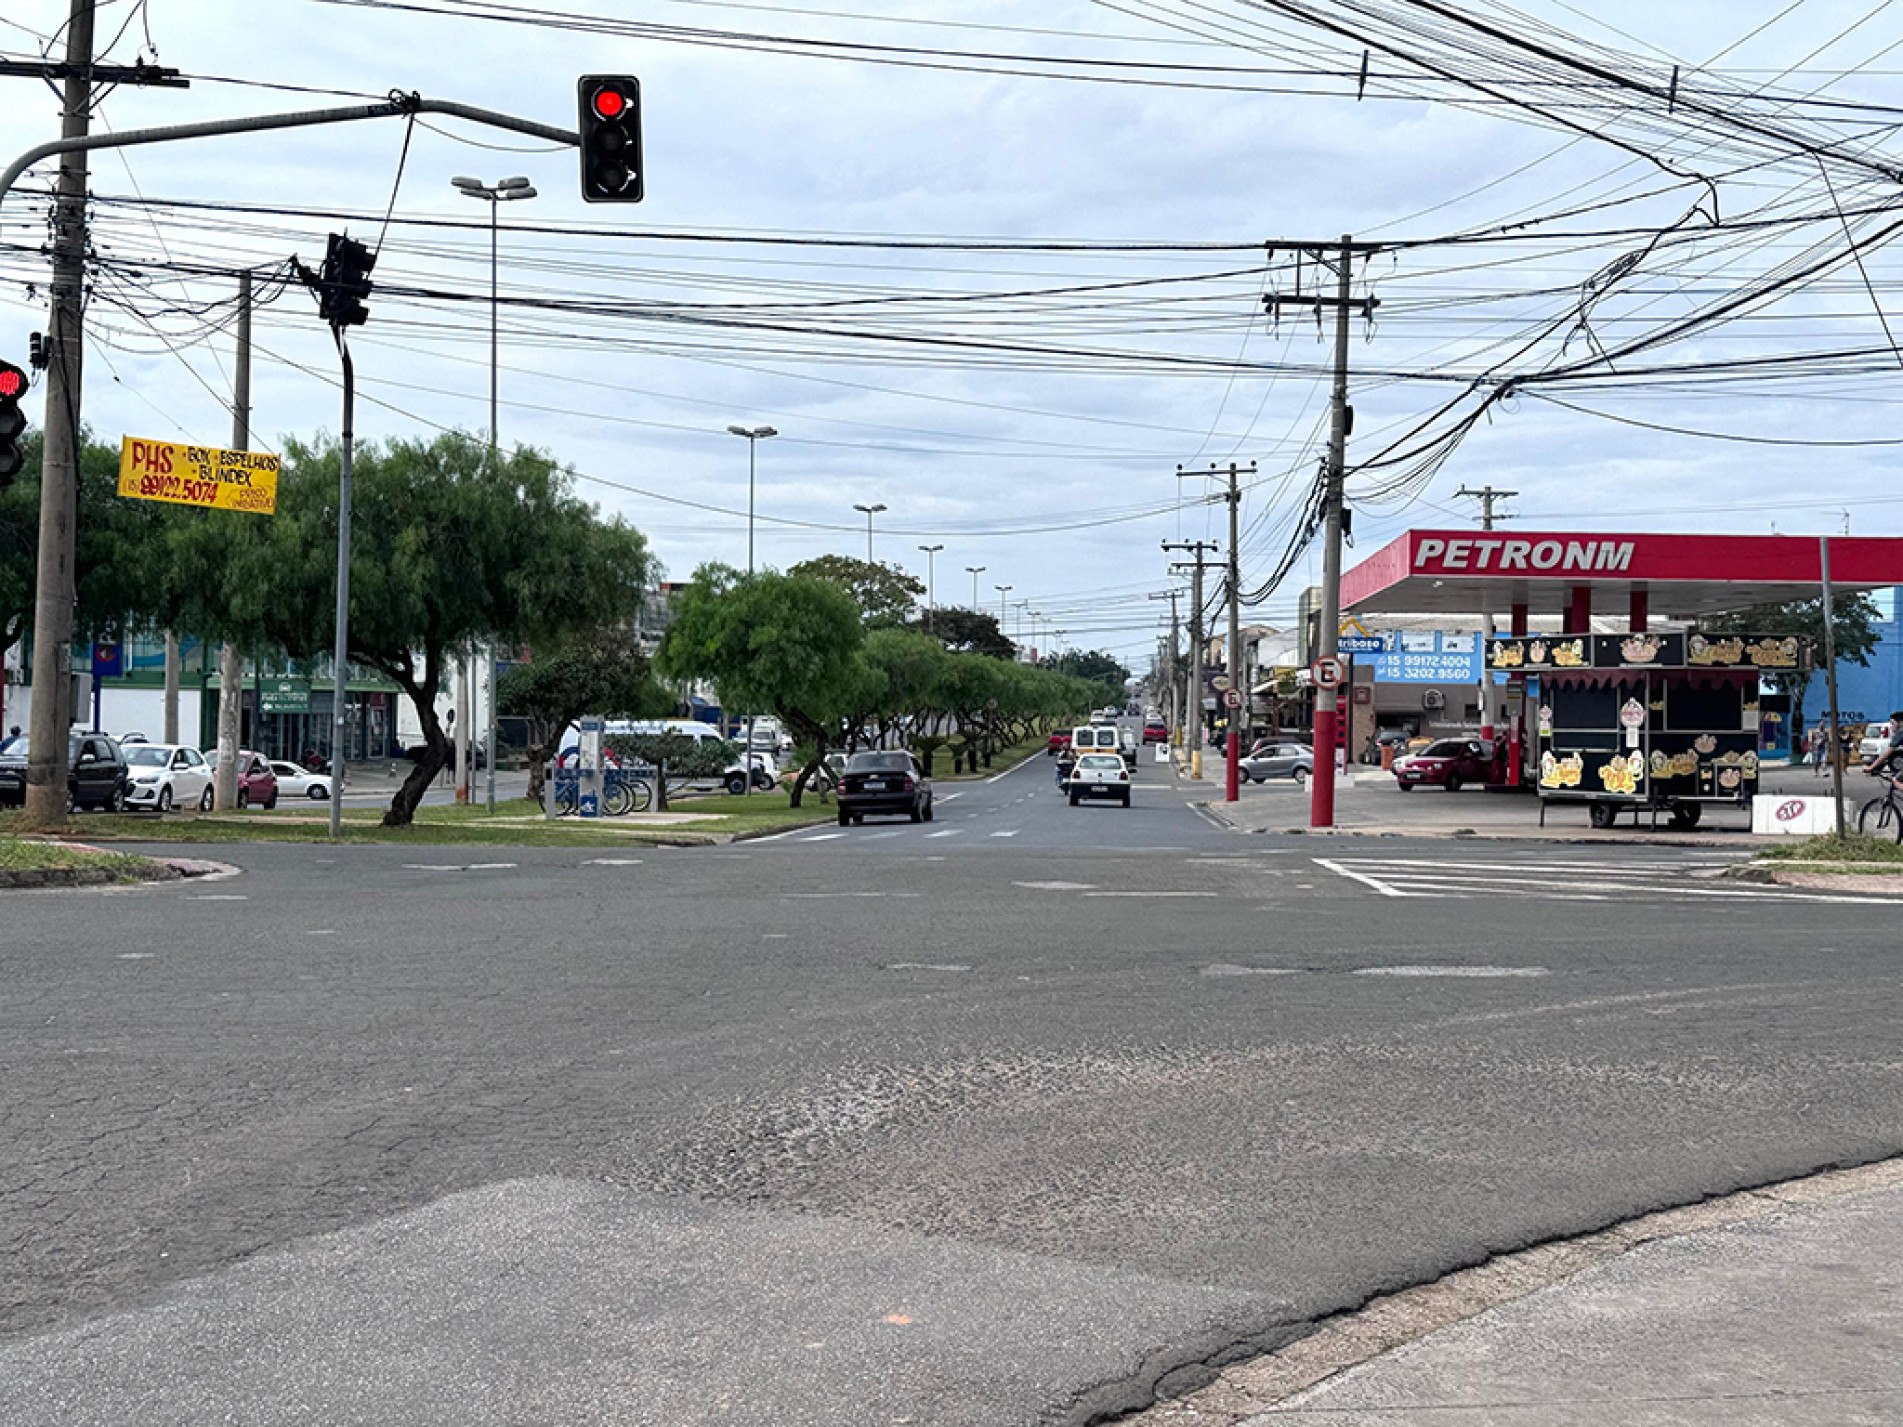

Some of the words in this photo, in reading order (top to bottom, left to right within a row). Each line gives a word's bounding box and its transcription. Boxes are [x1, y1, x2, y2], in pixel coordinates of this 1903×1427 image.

[131, 441, 175, 475] PHS
[220, 450, 279, 472] ESPELHOS
[198, 464, 253, 487] BLINDEX
[1413, 538, 1635, 572] PETRONM
[1387, 655, 1400, 666] 15
[1387, 667, 1400, 677] 15
